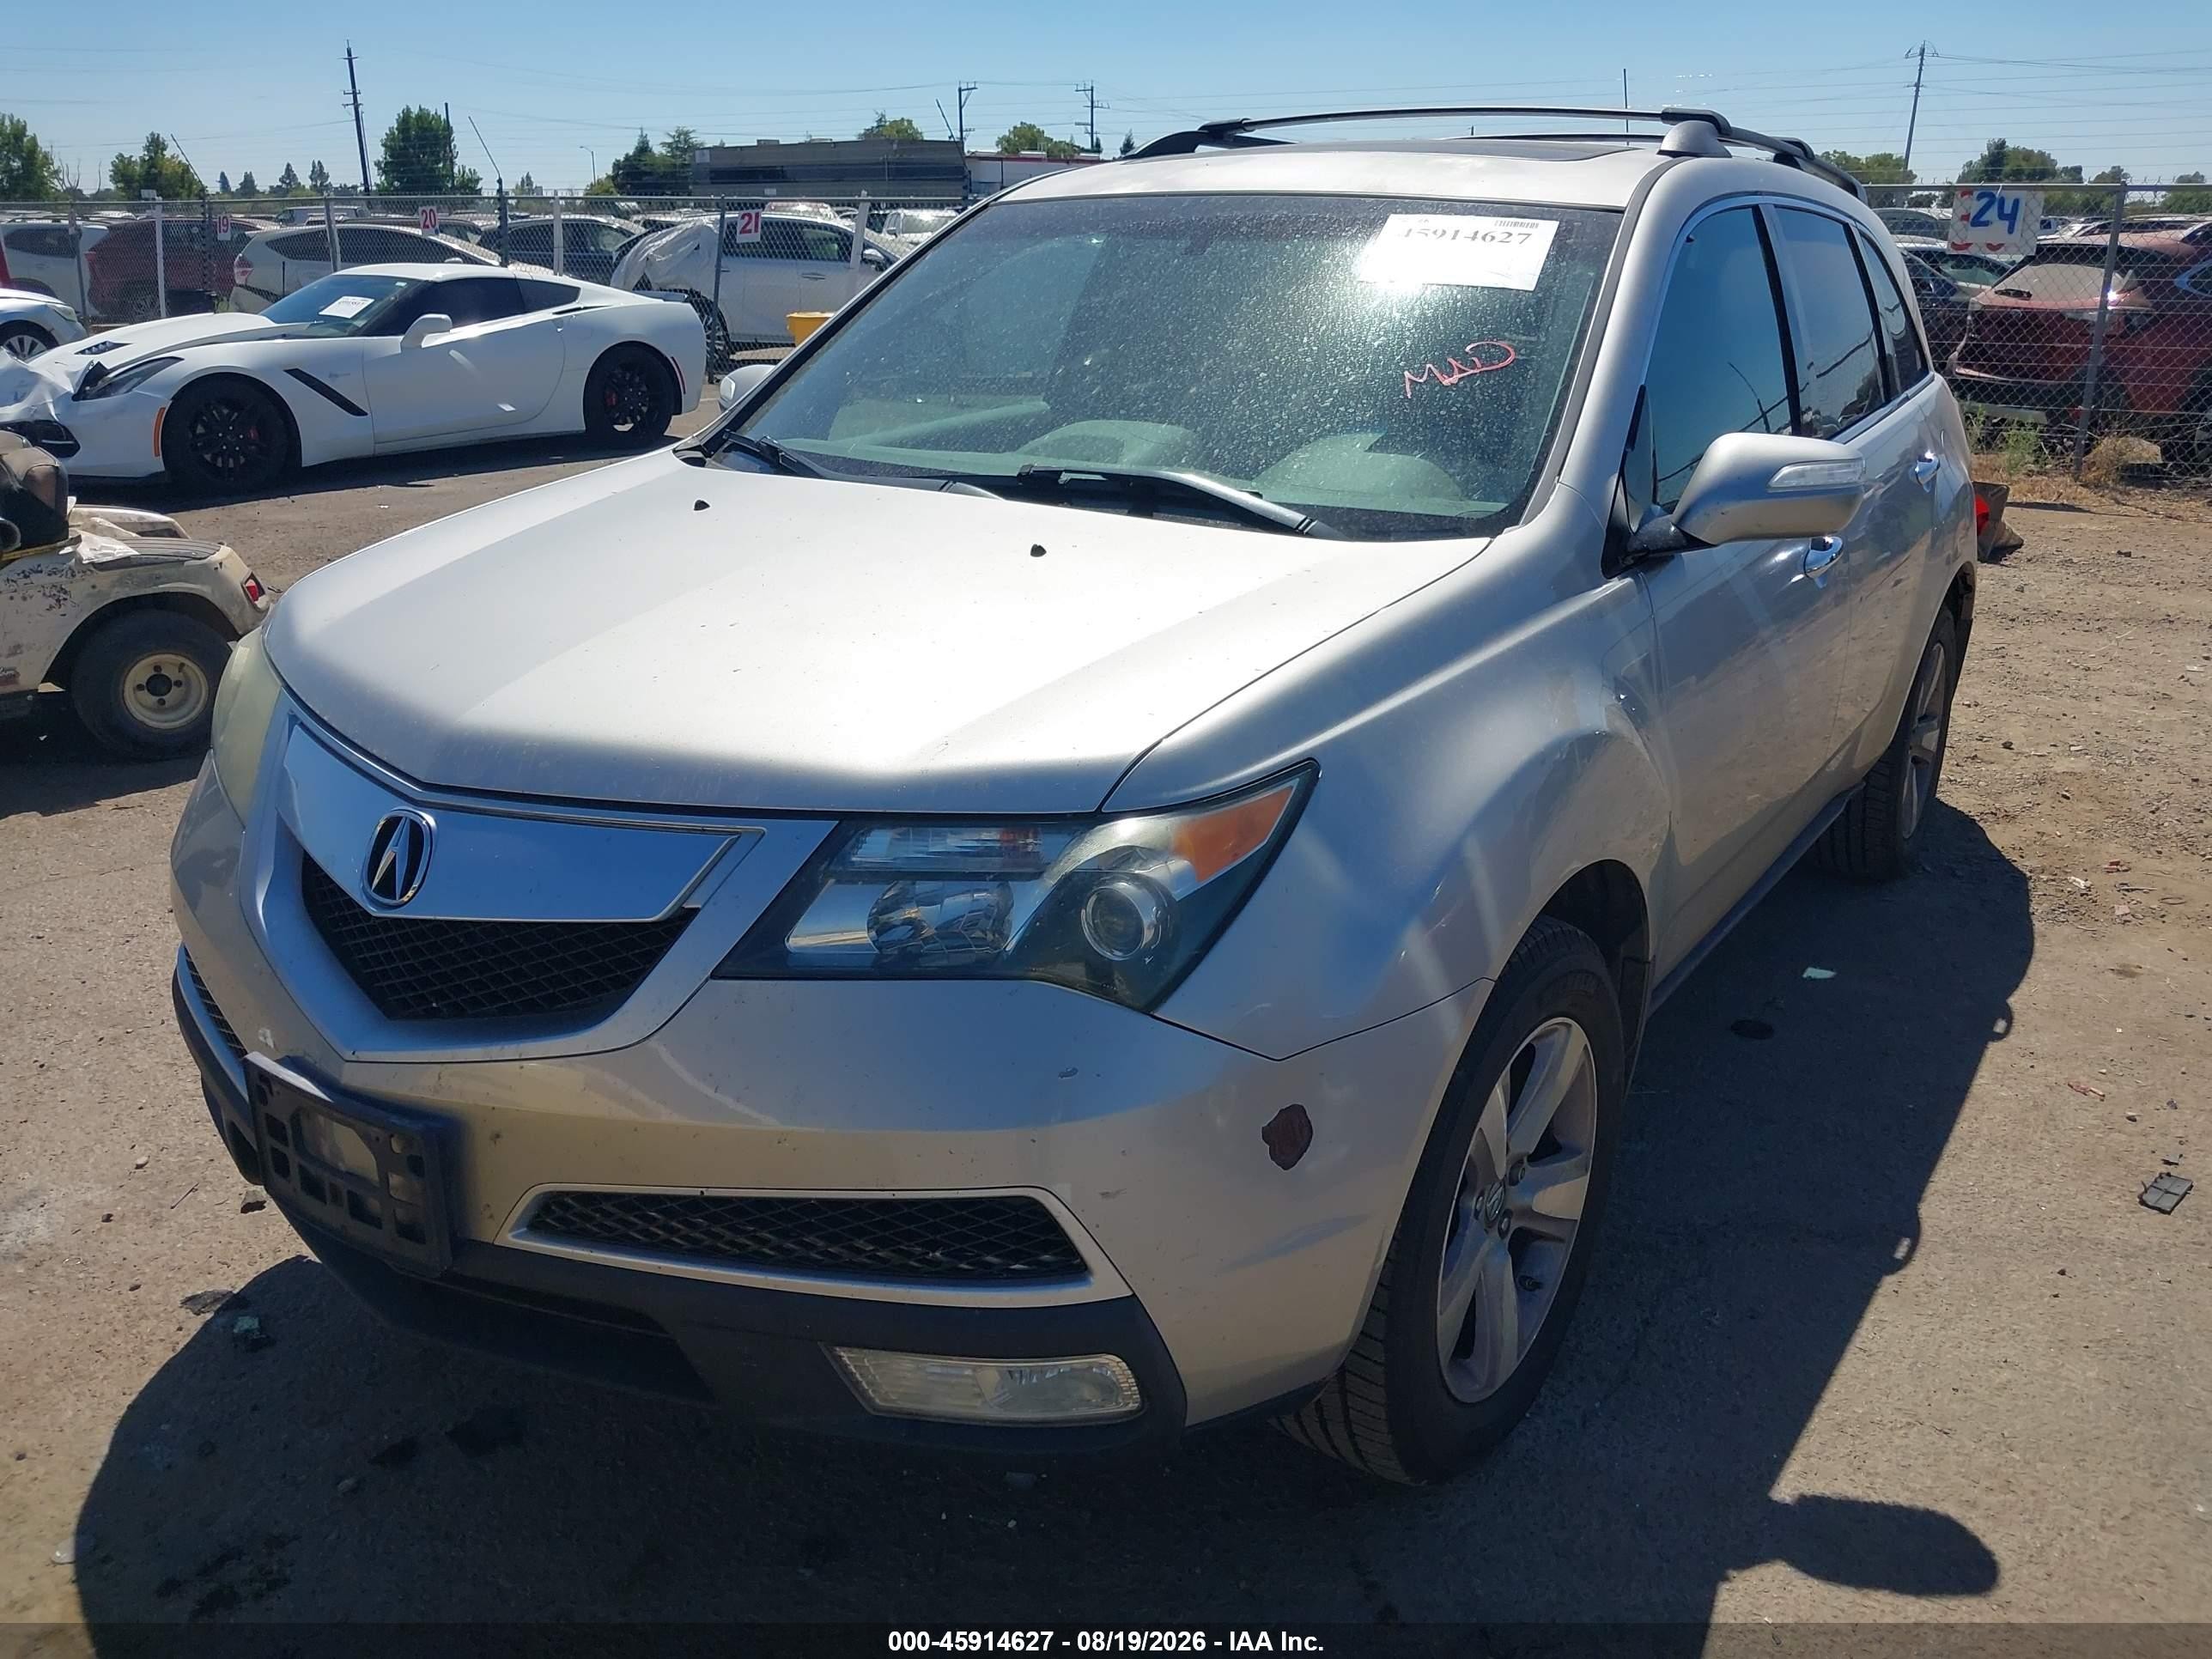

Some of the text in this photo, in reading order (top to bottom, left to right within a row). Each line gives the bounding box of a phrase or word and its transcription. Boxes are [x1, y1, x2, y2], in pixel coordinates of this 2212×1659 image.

[421, 208, 436, 229] 20
[739, 211, 760, 234] 21
[1970, 191, 2020, 234] 24
[218, 216, 229, 234] 19
